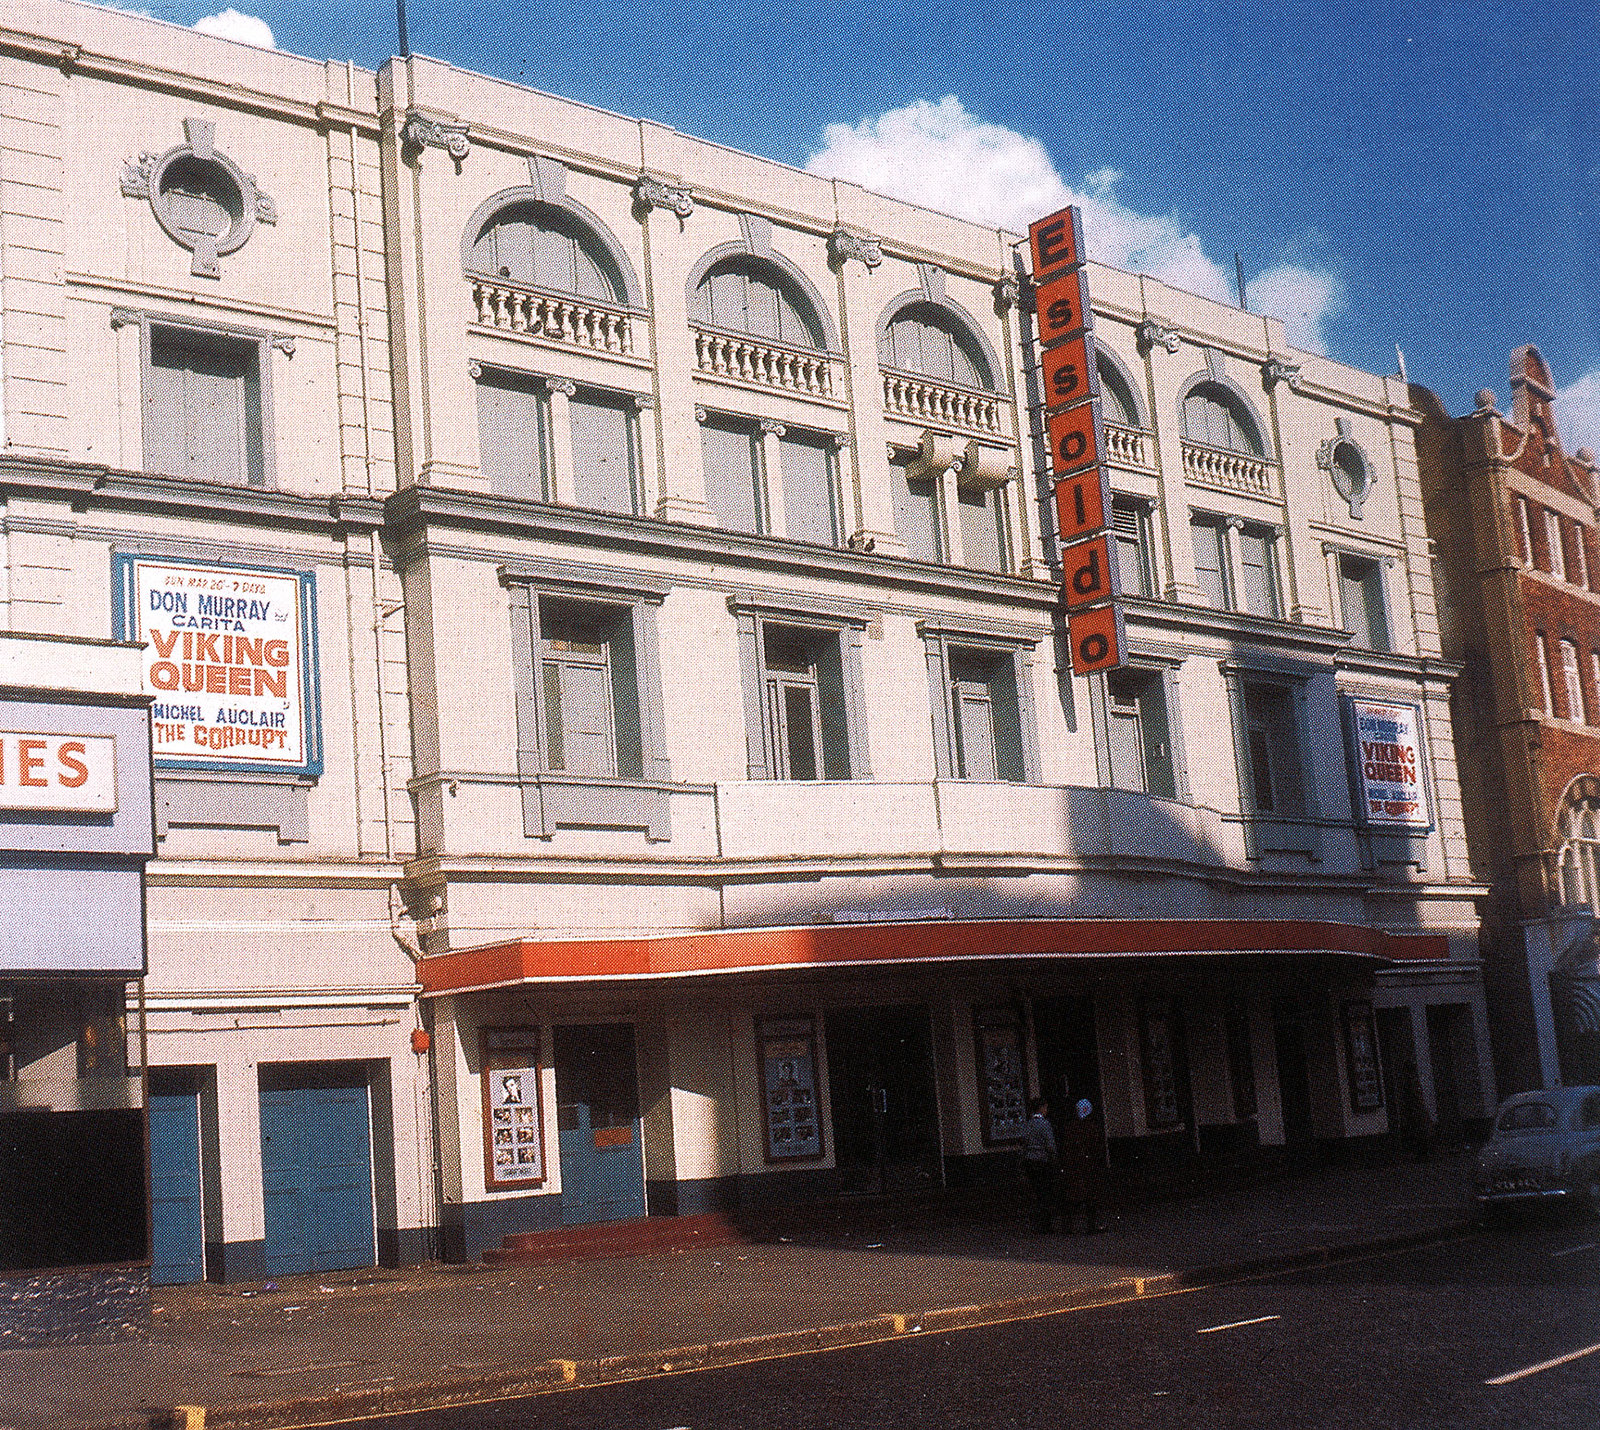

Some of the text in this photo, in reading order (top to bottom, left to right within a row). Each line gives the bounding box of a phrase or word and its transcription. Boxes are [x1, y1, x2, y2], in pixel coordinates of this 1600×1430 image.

[150, 589, 271, 621] DON MURRAY
[171, 614, 245, 632] CARITA
[149, 628, 290, 668] VIKING
[149, 660, 287, 698] QUEEN
[153, 703, 286, 728] MICHEL AUCLAIR
[154, 722, 287, 750] THE CORRUPT
